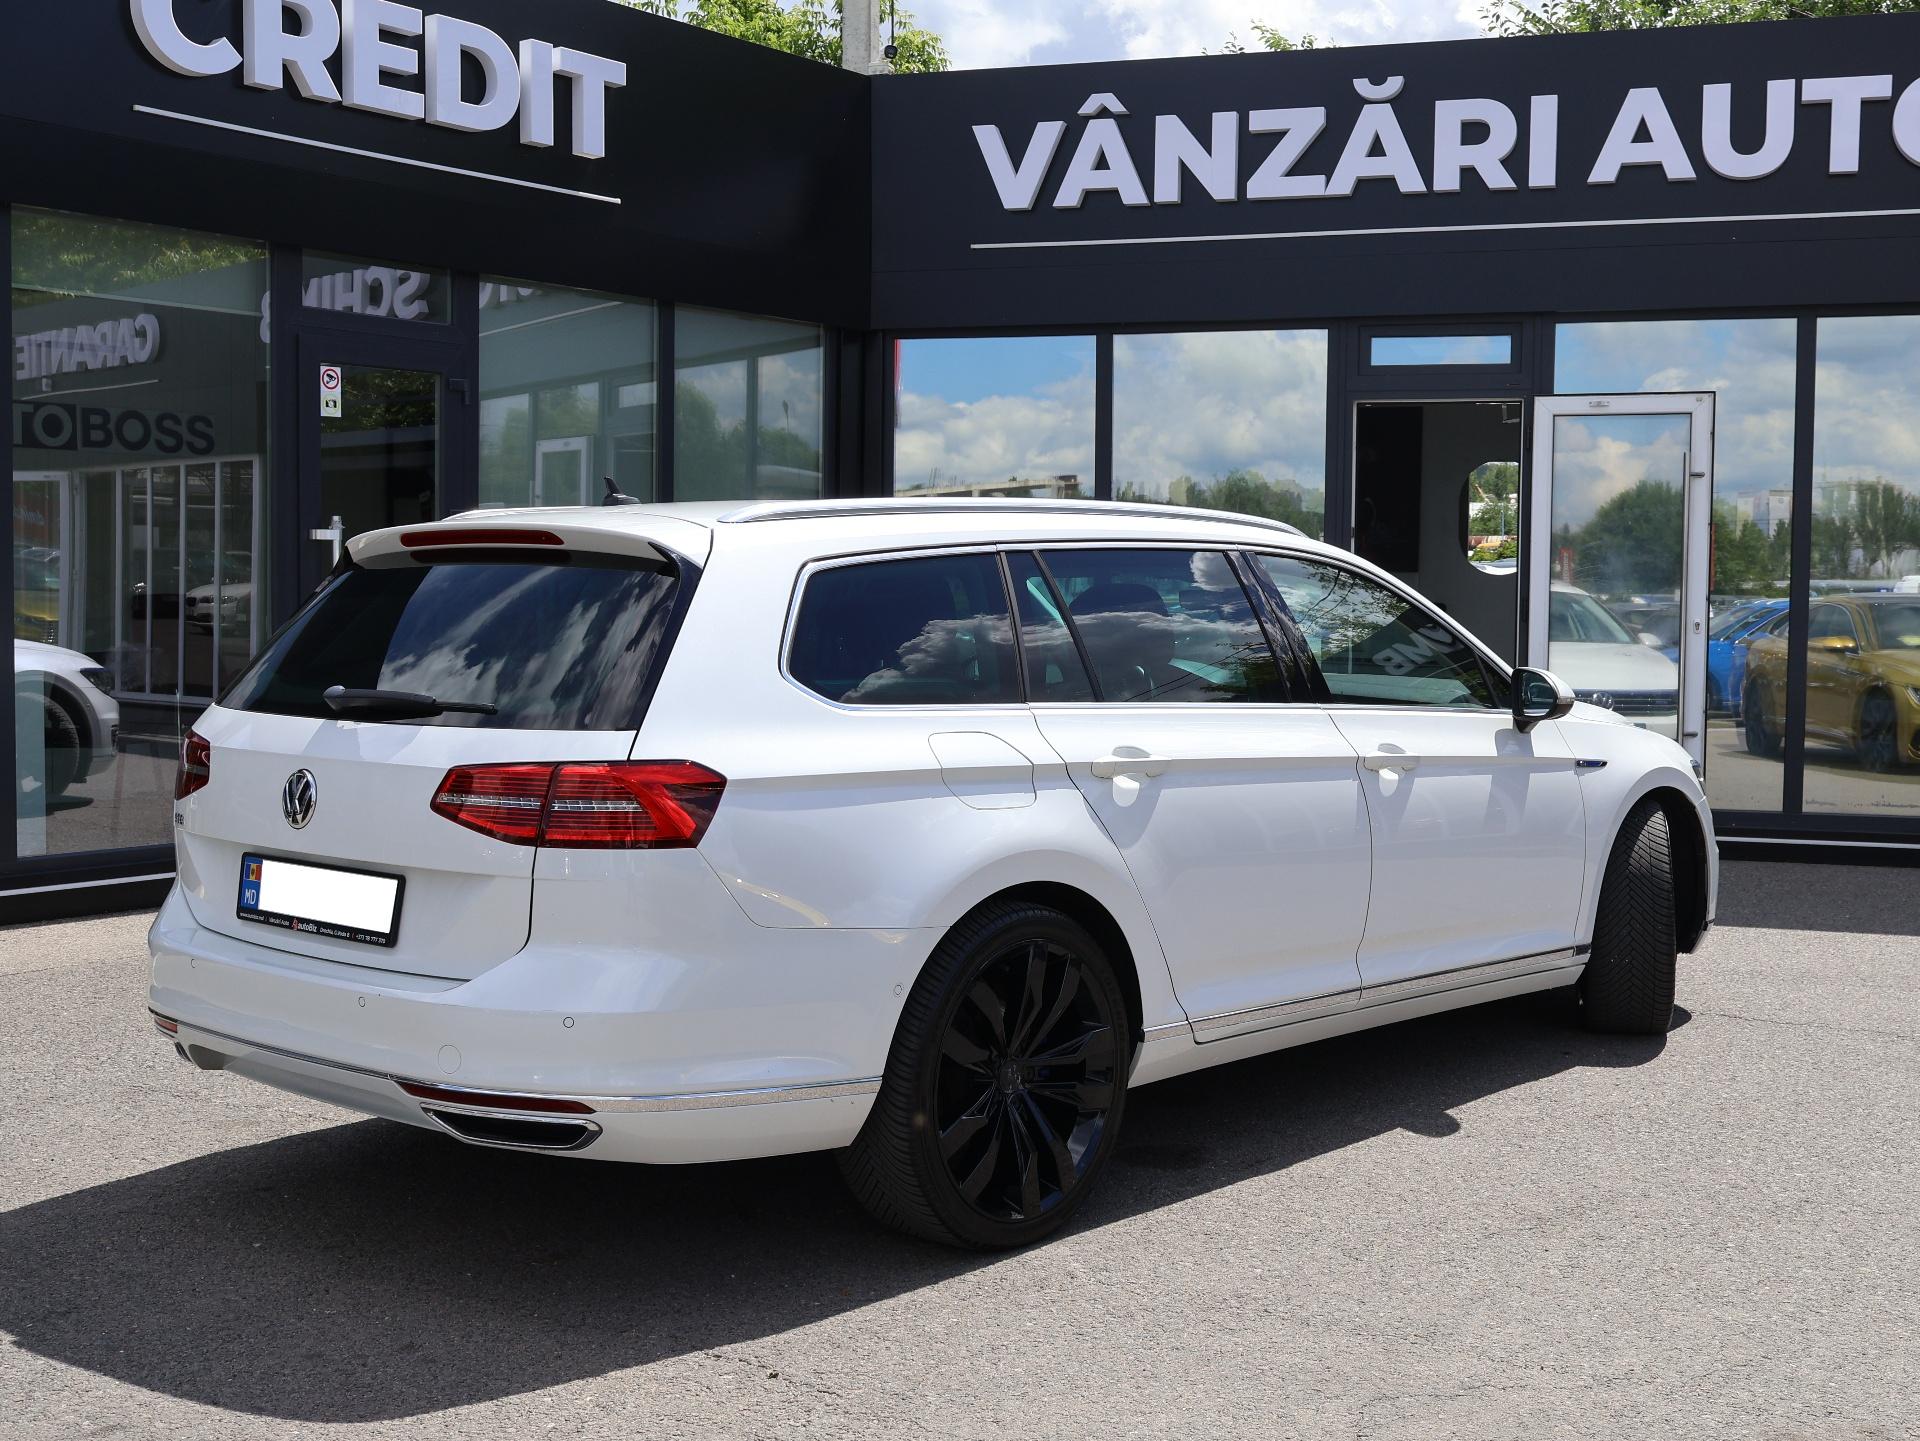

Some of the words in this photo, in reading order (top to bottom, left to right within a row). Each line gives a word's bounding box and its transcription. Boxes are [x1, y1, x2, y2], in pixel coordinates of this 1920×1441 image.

[129, 0, 627, 159] CREDIT
[972, 76, 1558, 211] VÂNZĂRI
[1587, 74, 1920, 185] AUT
[244, 888, 257, 905] MD
[297, 922, 318, 933] autoBiz
